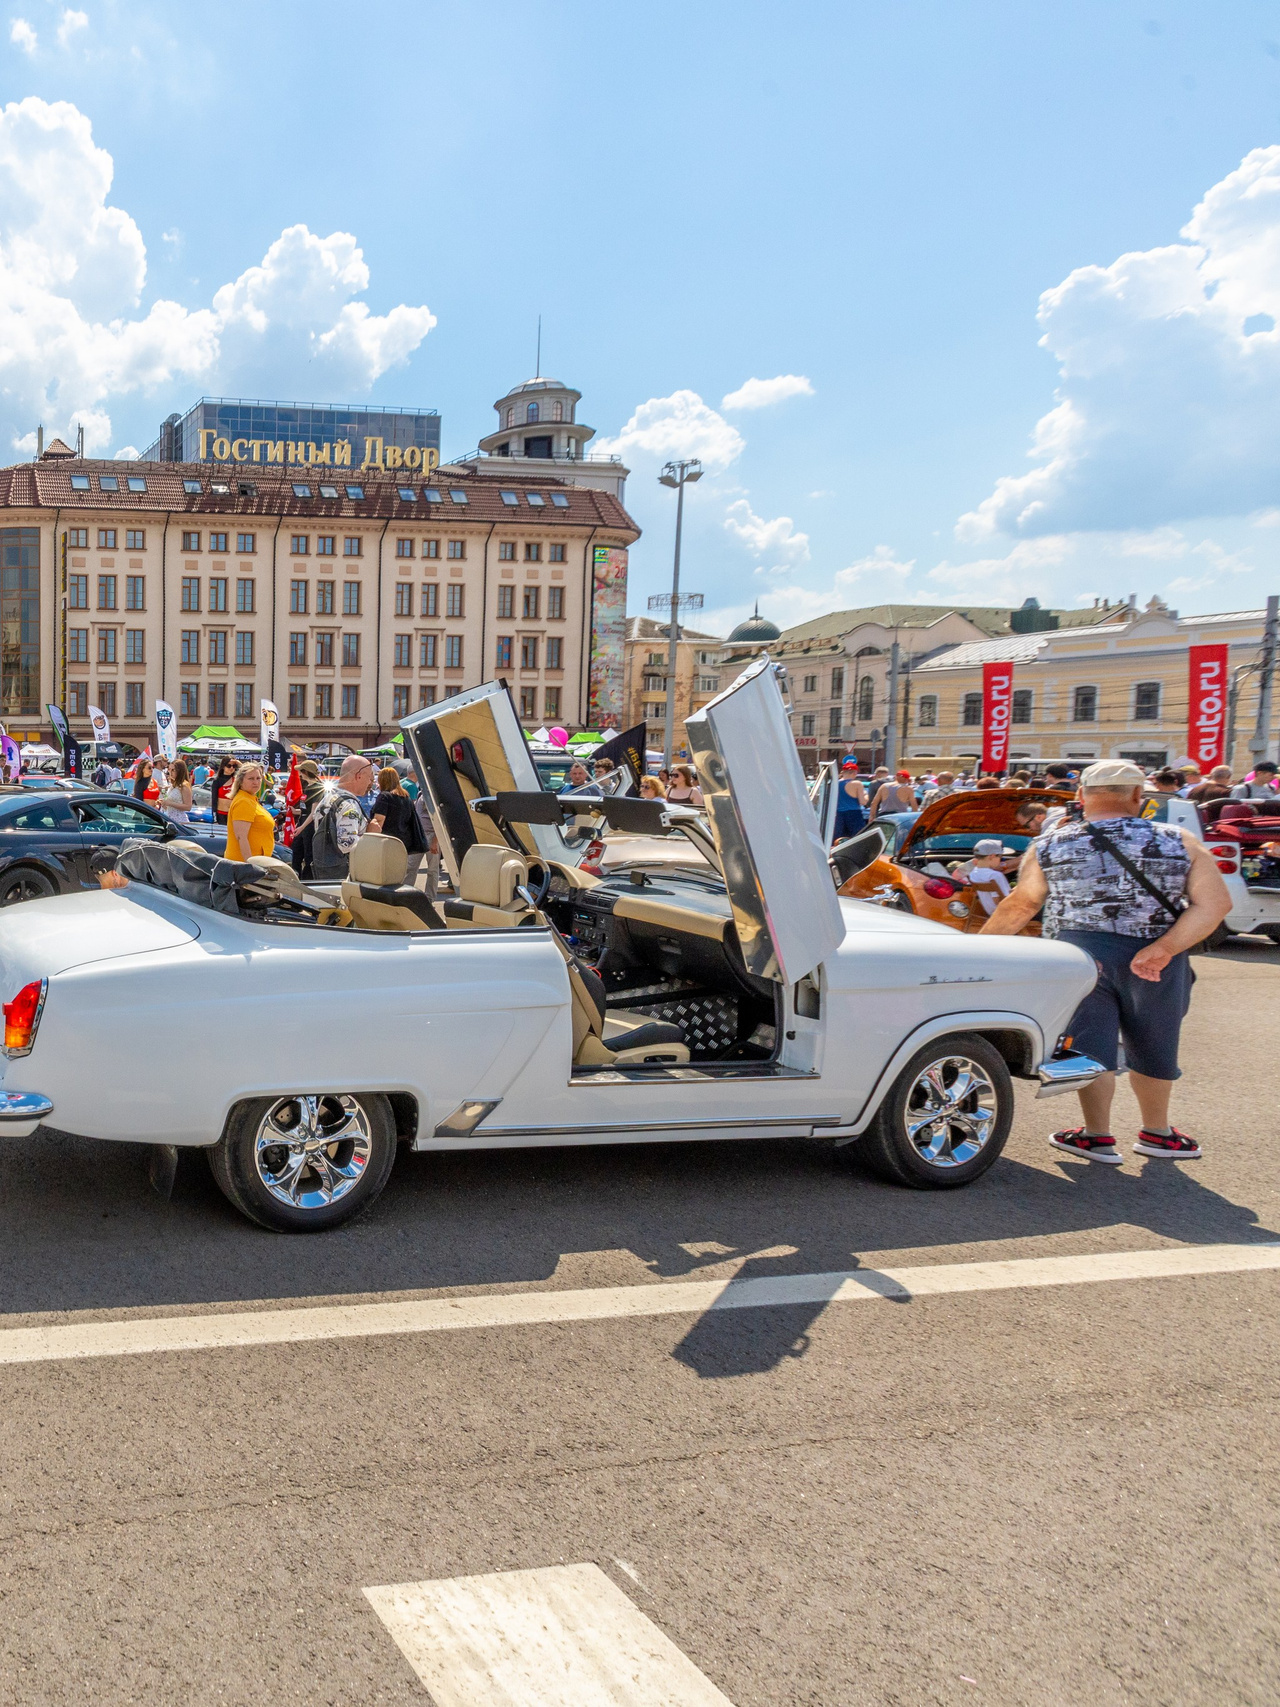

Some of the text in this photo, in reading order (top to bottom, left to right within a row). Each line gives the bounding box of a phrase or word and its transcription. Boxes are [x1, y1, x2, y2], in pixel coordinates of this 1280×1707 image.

[198, 429, 440, 477] Гостиный Двор
[989, 676, 1010, 760] auto.ru
[1196, 661, 1222, 762] auto.ru
